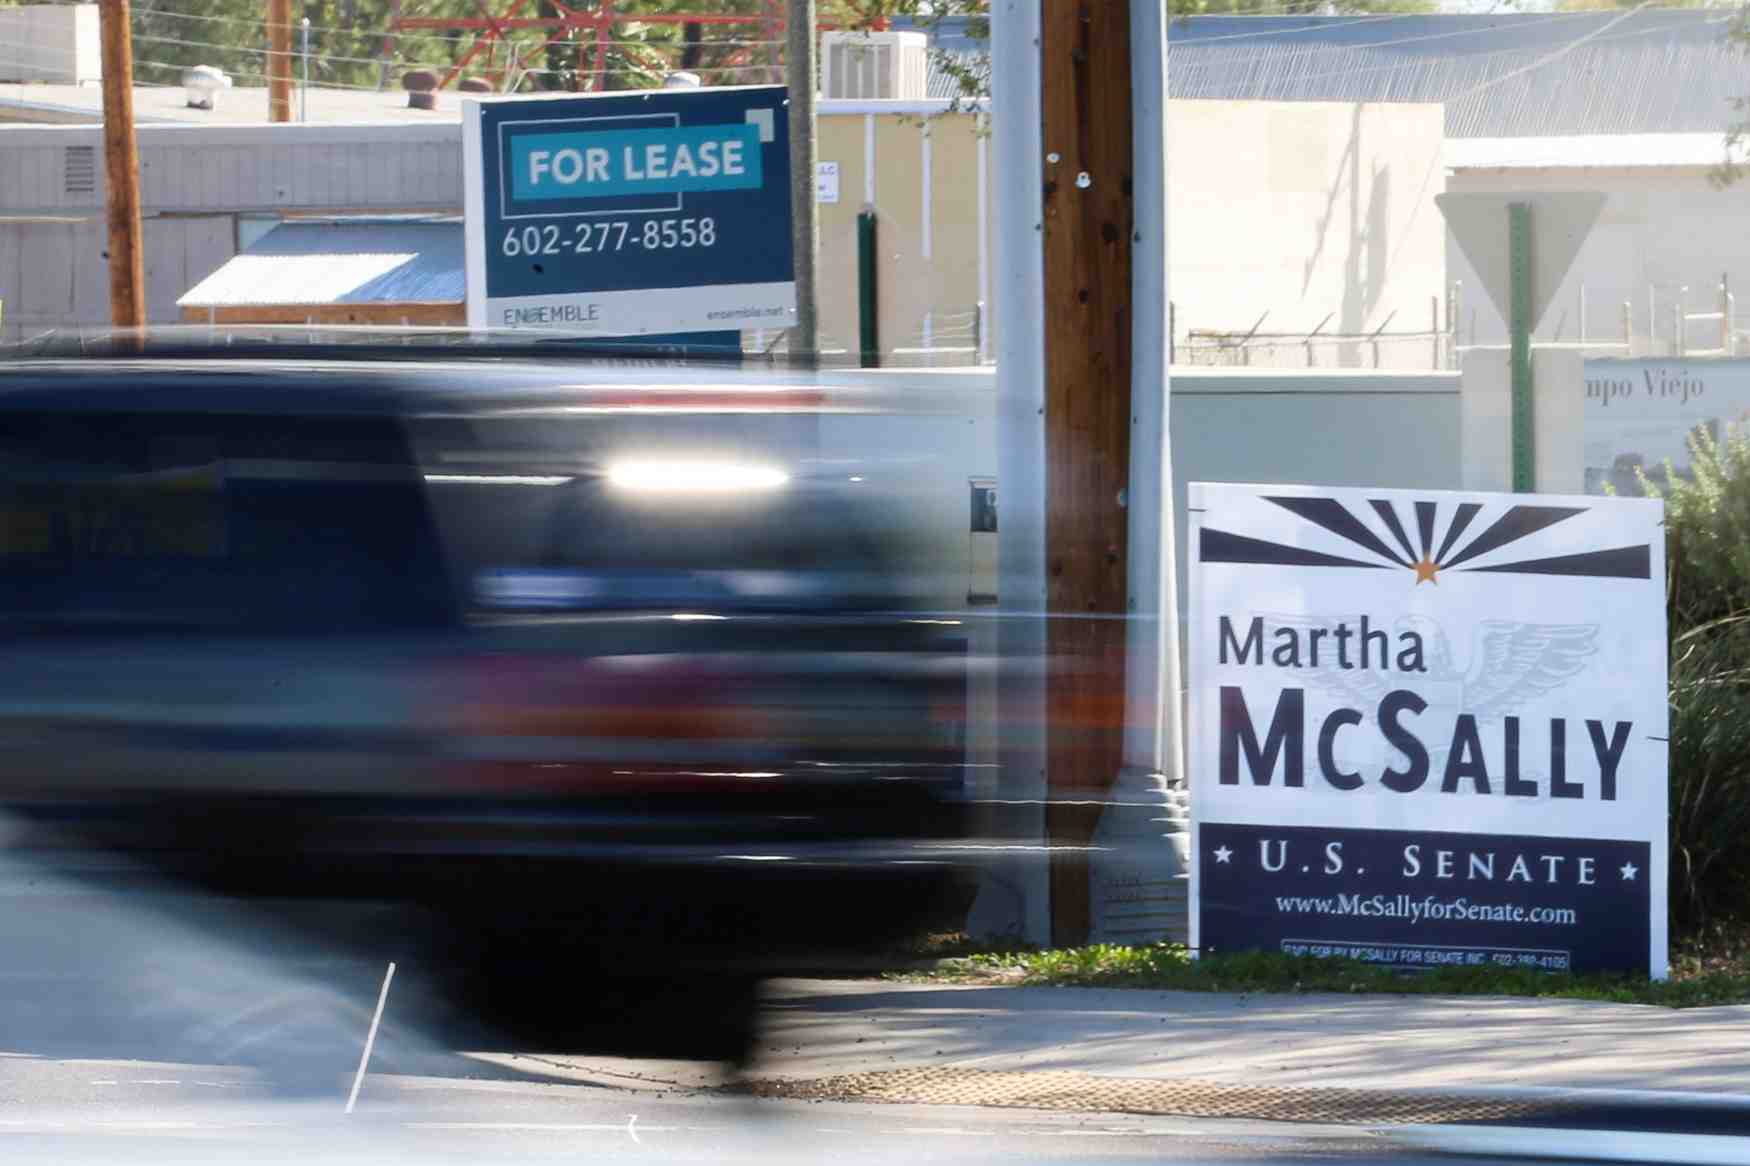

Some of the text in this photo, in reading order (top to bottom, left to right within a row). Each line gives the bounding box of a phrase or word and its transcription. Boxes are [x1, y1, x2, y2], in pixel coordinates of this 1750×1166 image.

[528, 139, 745, 185] FOR LEASE
[502, 217, 717, 257] 602-277-8558
[503, 303, 601, 325] ENSEMBLE
[1643, 367, 1704, 407] Viejo
[1218, 615, 1428, 672] Martha
[1259, 840, 1597, 885] U.S. SENATE
[1276, 894, 1577, 924] www.McSallyforSenate.com
